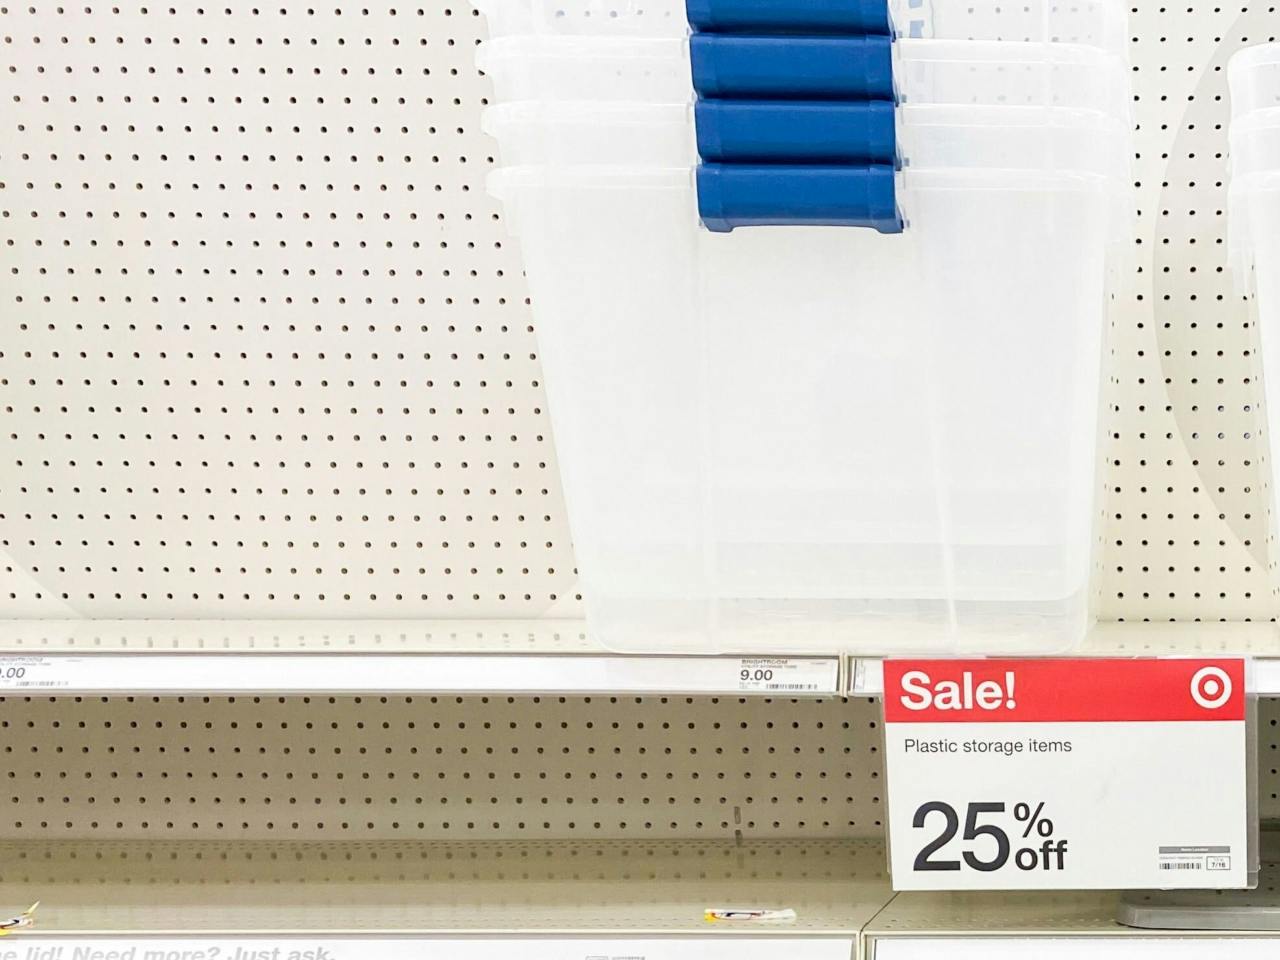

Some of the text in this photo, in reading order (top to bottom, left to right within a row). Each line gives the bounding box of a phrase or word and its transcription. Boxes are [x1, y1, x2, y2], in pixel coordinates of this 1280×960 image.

[0, 667, 26, 679] .00
[740, 669, 773, 681] 9.00
[900, 670, 1016, 711] Sale!
[904, 738, 1072, 756] Plastic storage items
[1014, 839, 1068, 871] off
